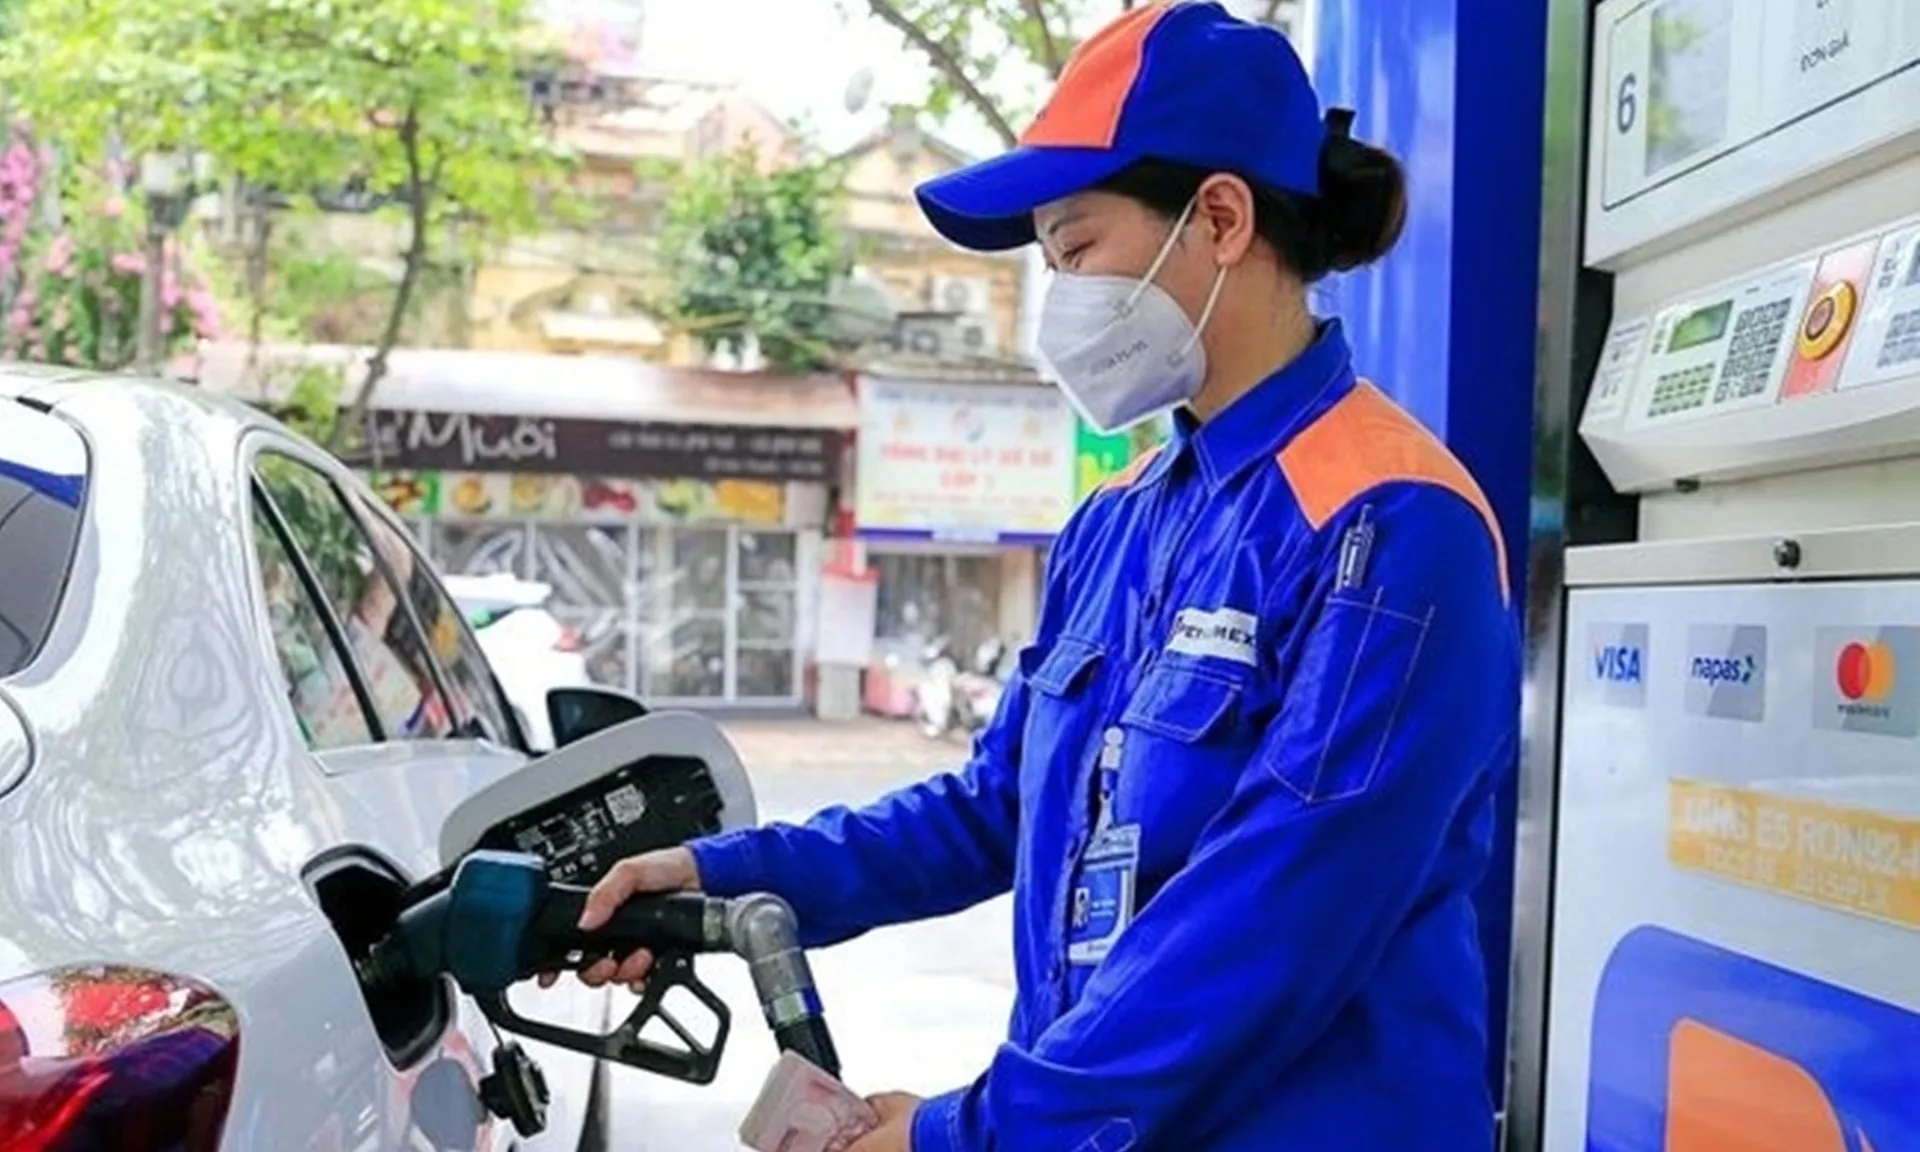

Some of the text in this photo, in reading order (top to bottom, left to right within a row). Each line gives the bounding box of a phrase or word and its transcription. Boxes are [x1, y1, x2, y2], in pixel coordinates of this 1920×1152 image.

[1617, 72, 1636, 134] 6
[1595, 647, 1640, 682] VISA
[1692, 657, 1739, 686] napas
